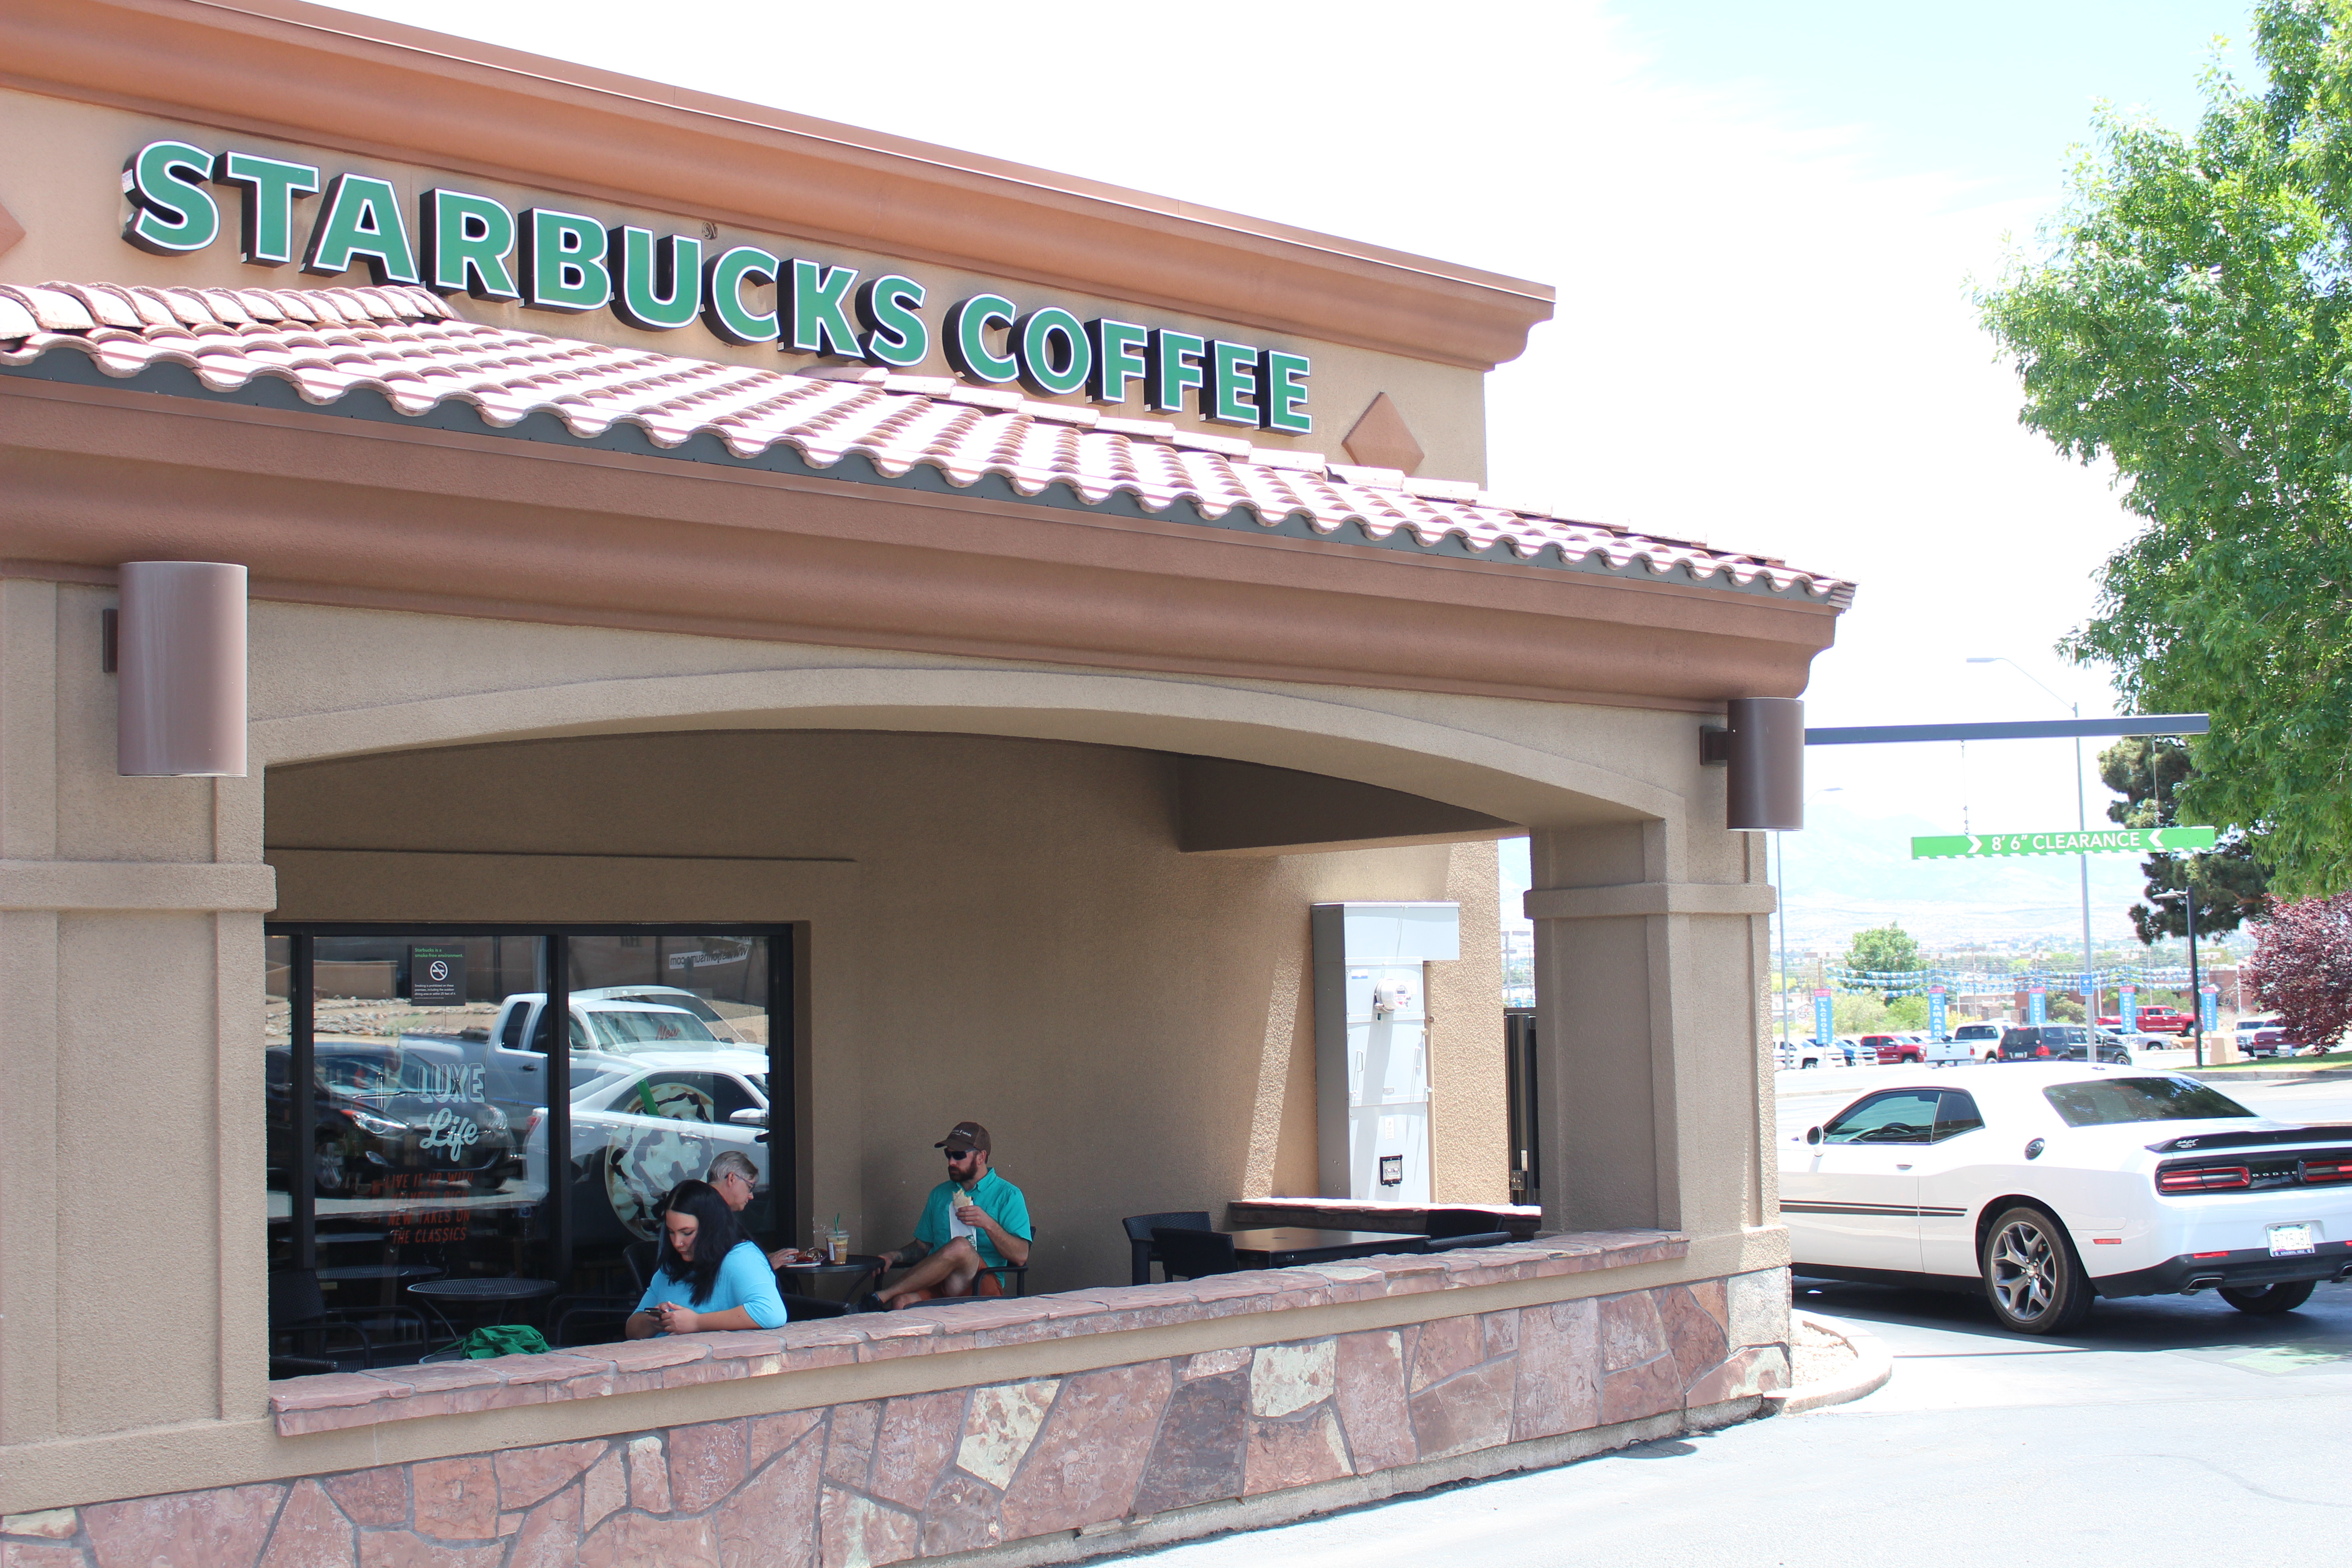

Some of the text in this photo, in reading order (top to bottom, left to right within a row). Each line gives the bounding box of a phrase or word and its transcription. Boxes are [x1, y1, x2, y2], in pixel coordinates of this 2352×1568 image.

[132, 140, 1313, 435] STARBUCKS COFFEE
[1992, 835, 2005, 851] 8'
[2033, 832, 2140, 849] CLEARANCE
[1820, 1002, 1828, 1043] LACROSSE
[1932, 999, 1942, 1037] CAMARO
[655, 1025, 681, 1040] New
[418, 1063, 486, 1103] LUXE
[420, 1108, 480, 1161] Life
[385, 1171, 474, 1188] LIVE IT UP WITH
[443, 1190, 470, 1205] RICH
[388, 1209, 471, 1226] NEW TAKES ON
[393, 1227, 467, 1244] THE CLASSICS
[2274, 1232, 2311, 1248] BZY5481
